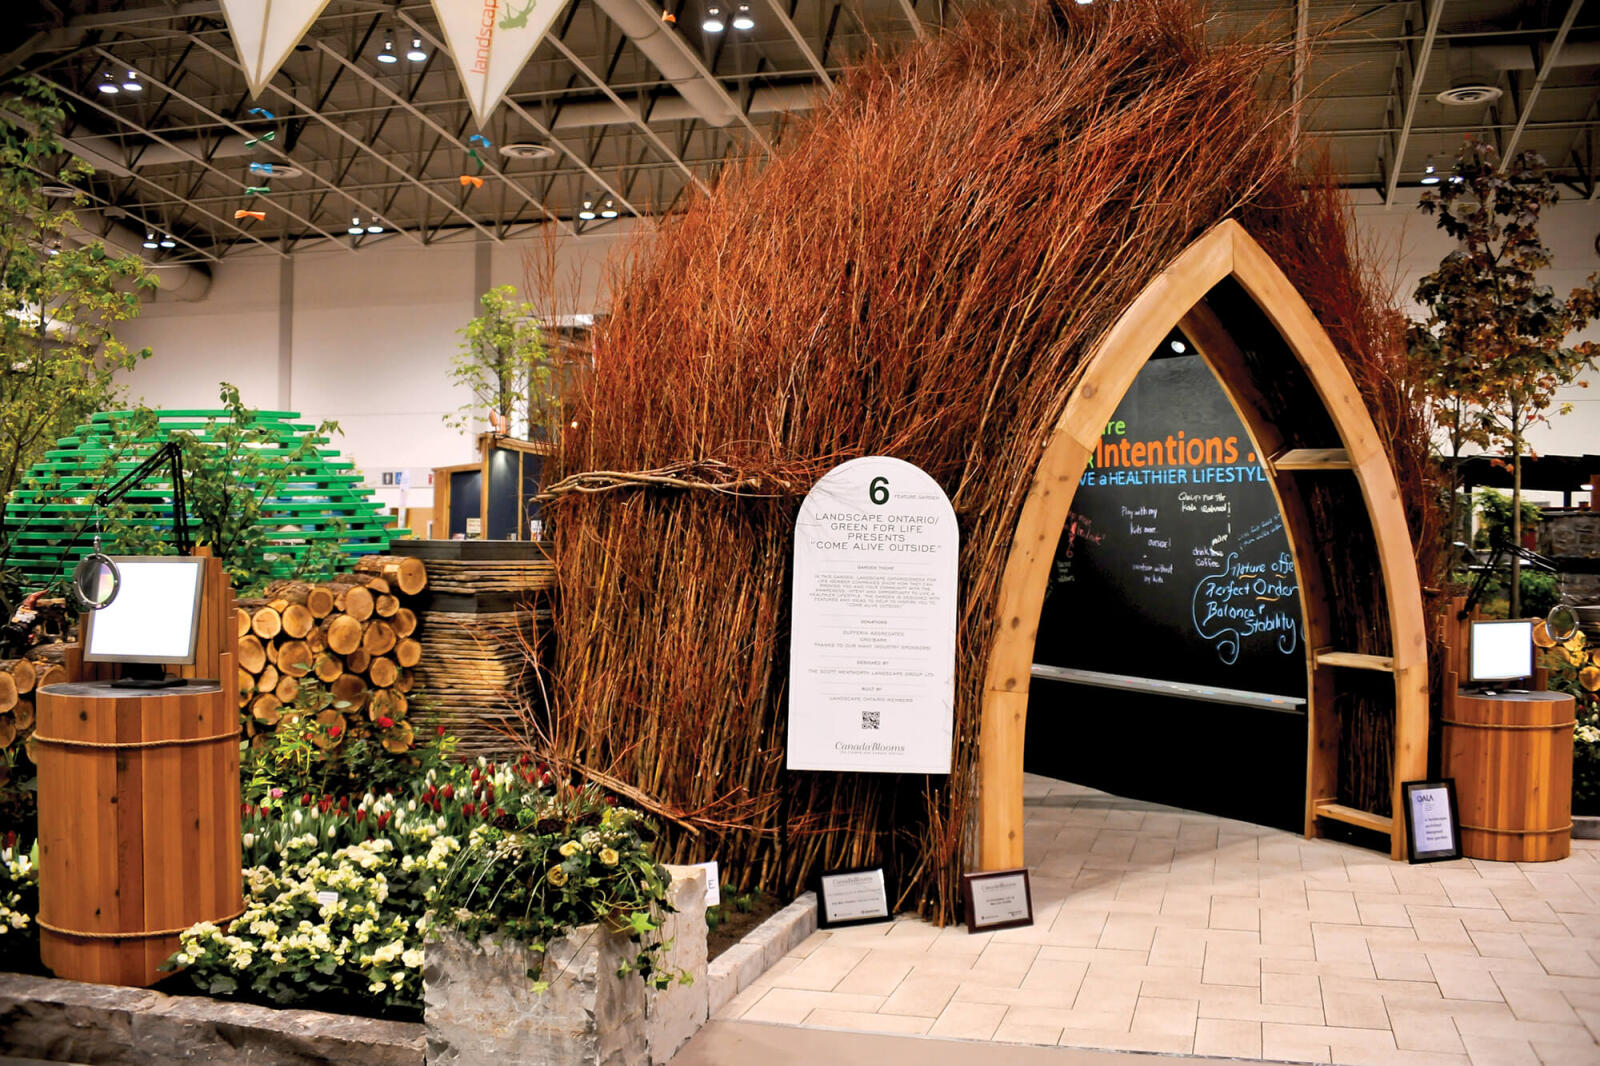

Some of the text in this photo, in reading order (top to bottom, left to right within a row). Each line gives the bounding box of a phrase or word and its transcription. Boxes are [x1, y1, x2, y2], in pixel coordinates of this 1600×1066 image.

[1100, 474, 1107, 485] a
[1109, 469, 1188, 486] HEALTHIER
[1193, 466, 1268, 484] LIFESTYL
[869, 476, 890, 505] 6
[815, 513, 939, 526] LANDSCAPE ONTARIO/
[830, 523, 923, 534] GREEN FOR LIFE
[848, 533, 905, 543] PRESENTS
[853, 543, 885, 551] ALIVE
[1206, 580, 1250, 602] Perfect
